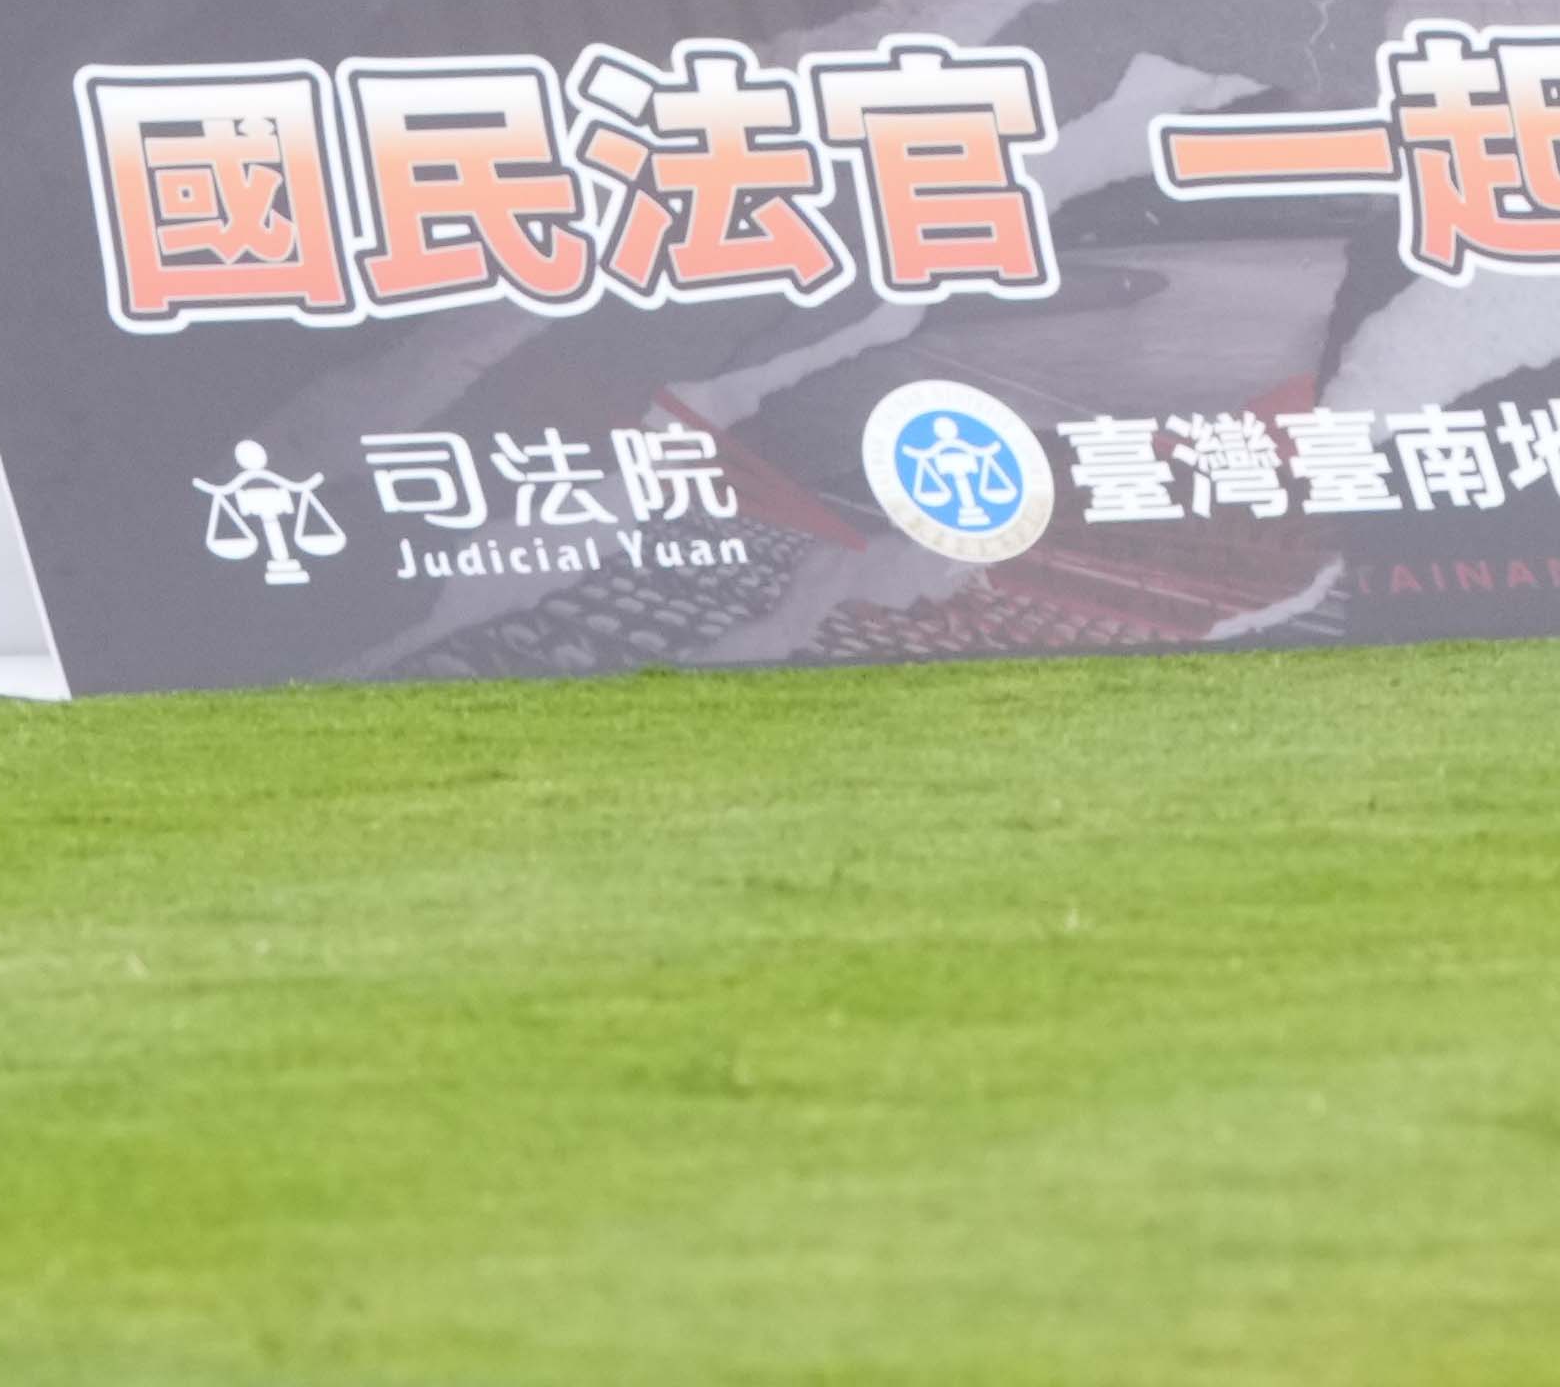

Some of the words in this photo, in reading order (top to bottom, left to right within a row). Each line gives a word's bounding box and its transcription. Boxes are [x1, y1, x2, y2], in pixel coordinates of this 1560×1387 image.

[74, 33, 1059, 333] 國民法官
[360, 422, 738, 529] 司法院
[396, 536, 602, 580] Judicial
[616, 528, 750, 570] Yuan
